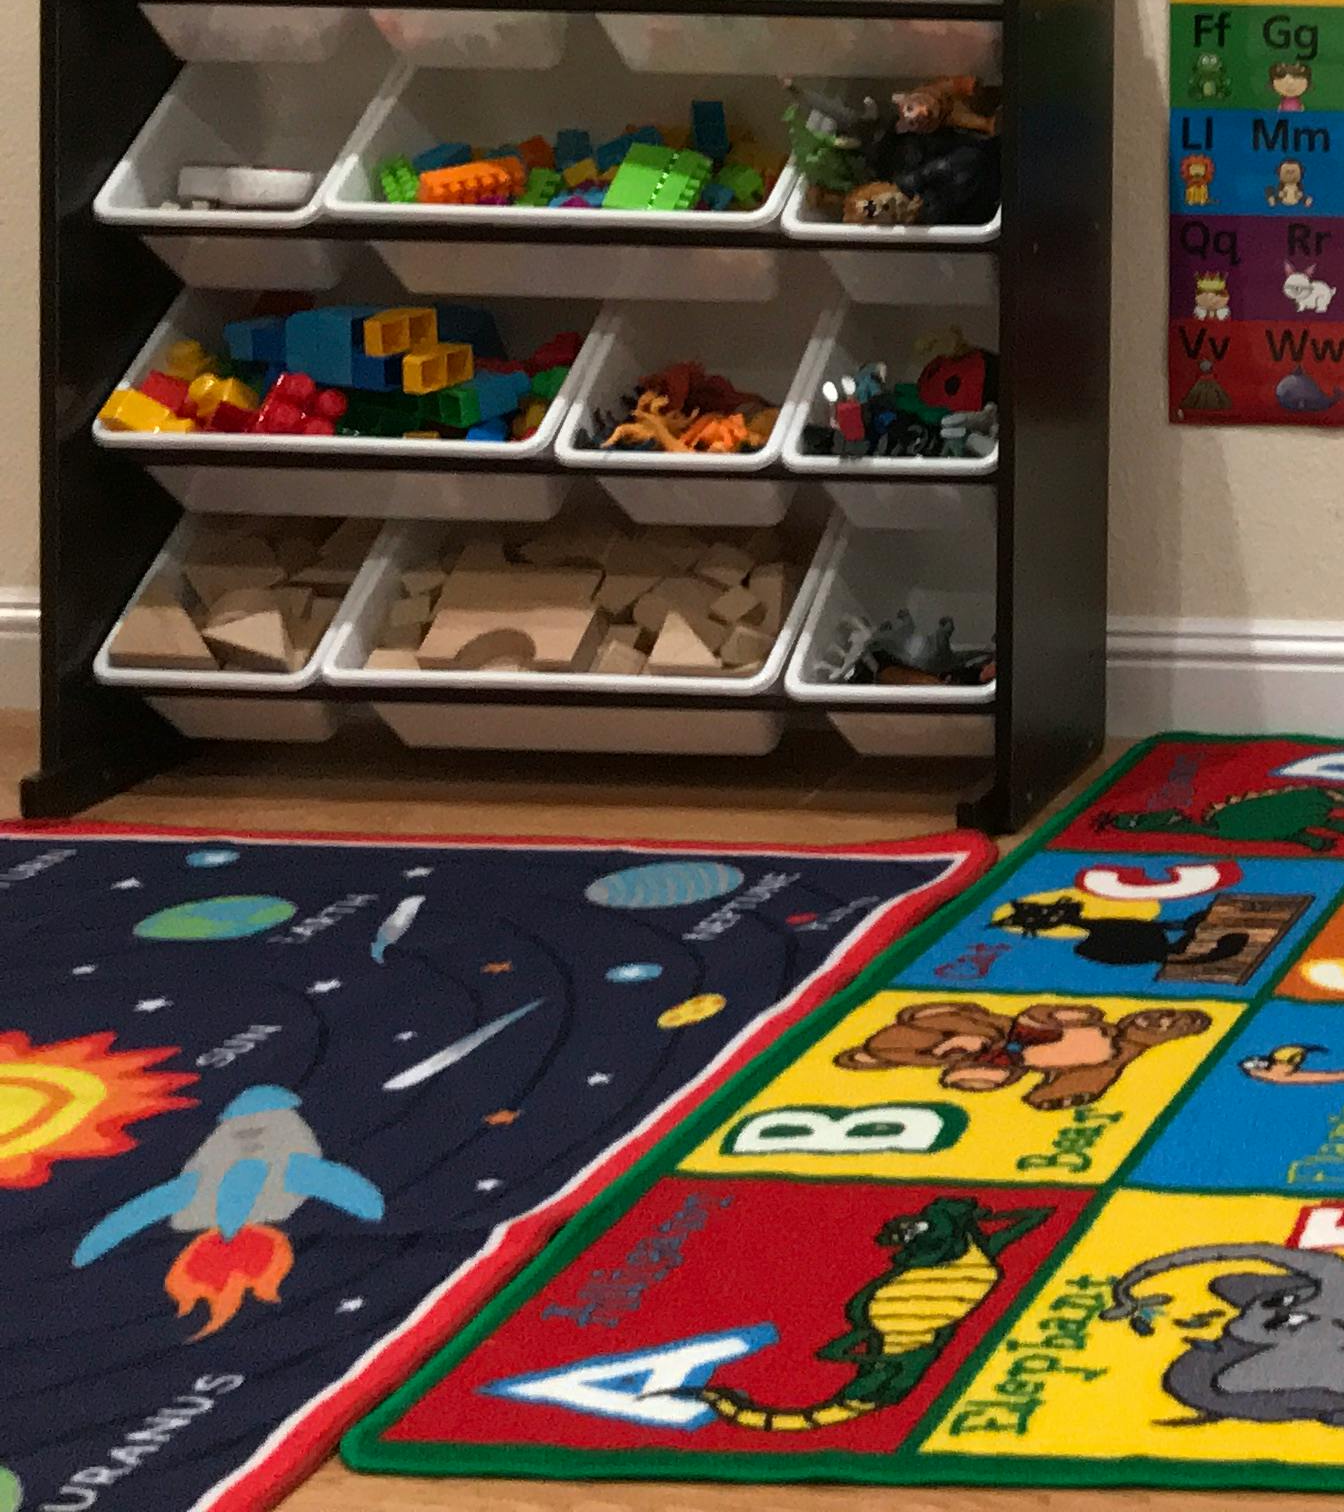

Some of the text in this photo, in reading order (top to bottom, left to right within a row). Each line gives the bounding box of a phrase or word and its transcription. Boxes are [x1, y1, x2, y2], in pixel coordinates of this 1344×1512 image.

[1252, 119, 1330, 152] Mm
[1075, 860, 1245, 902] C
[196, 1023, 284, 1072] SUN
[722, 1100, 969, 1160] B
[1017, 1100, 1126, 1176] Bear
[481, 1322, 782, 1434] A
[949, 1273, 1118, 1442] Elephant
[40, 1374, 246, 1512] URANUS
